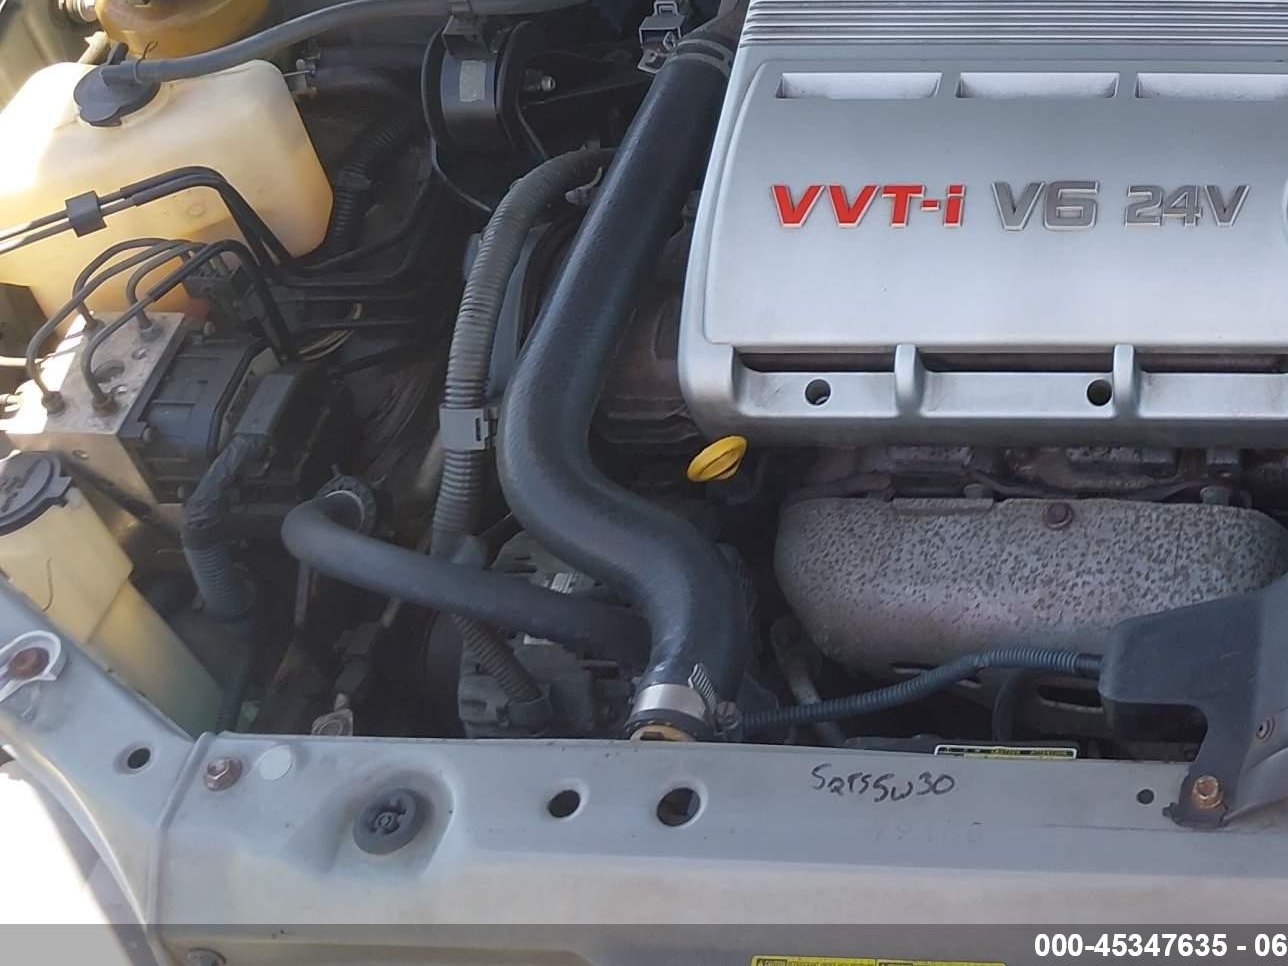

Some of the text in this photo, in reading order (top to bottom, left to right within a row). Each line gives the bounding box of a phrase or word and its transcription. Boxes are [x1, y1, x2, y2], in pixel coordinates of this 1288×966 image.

[770, 181, 1251, 232] VVT-i V6 24V
